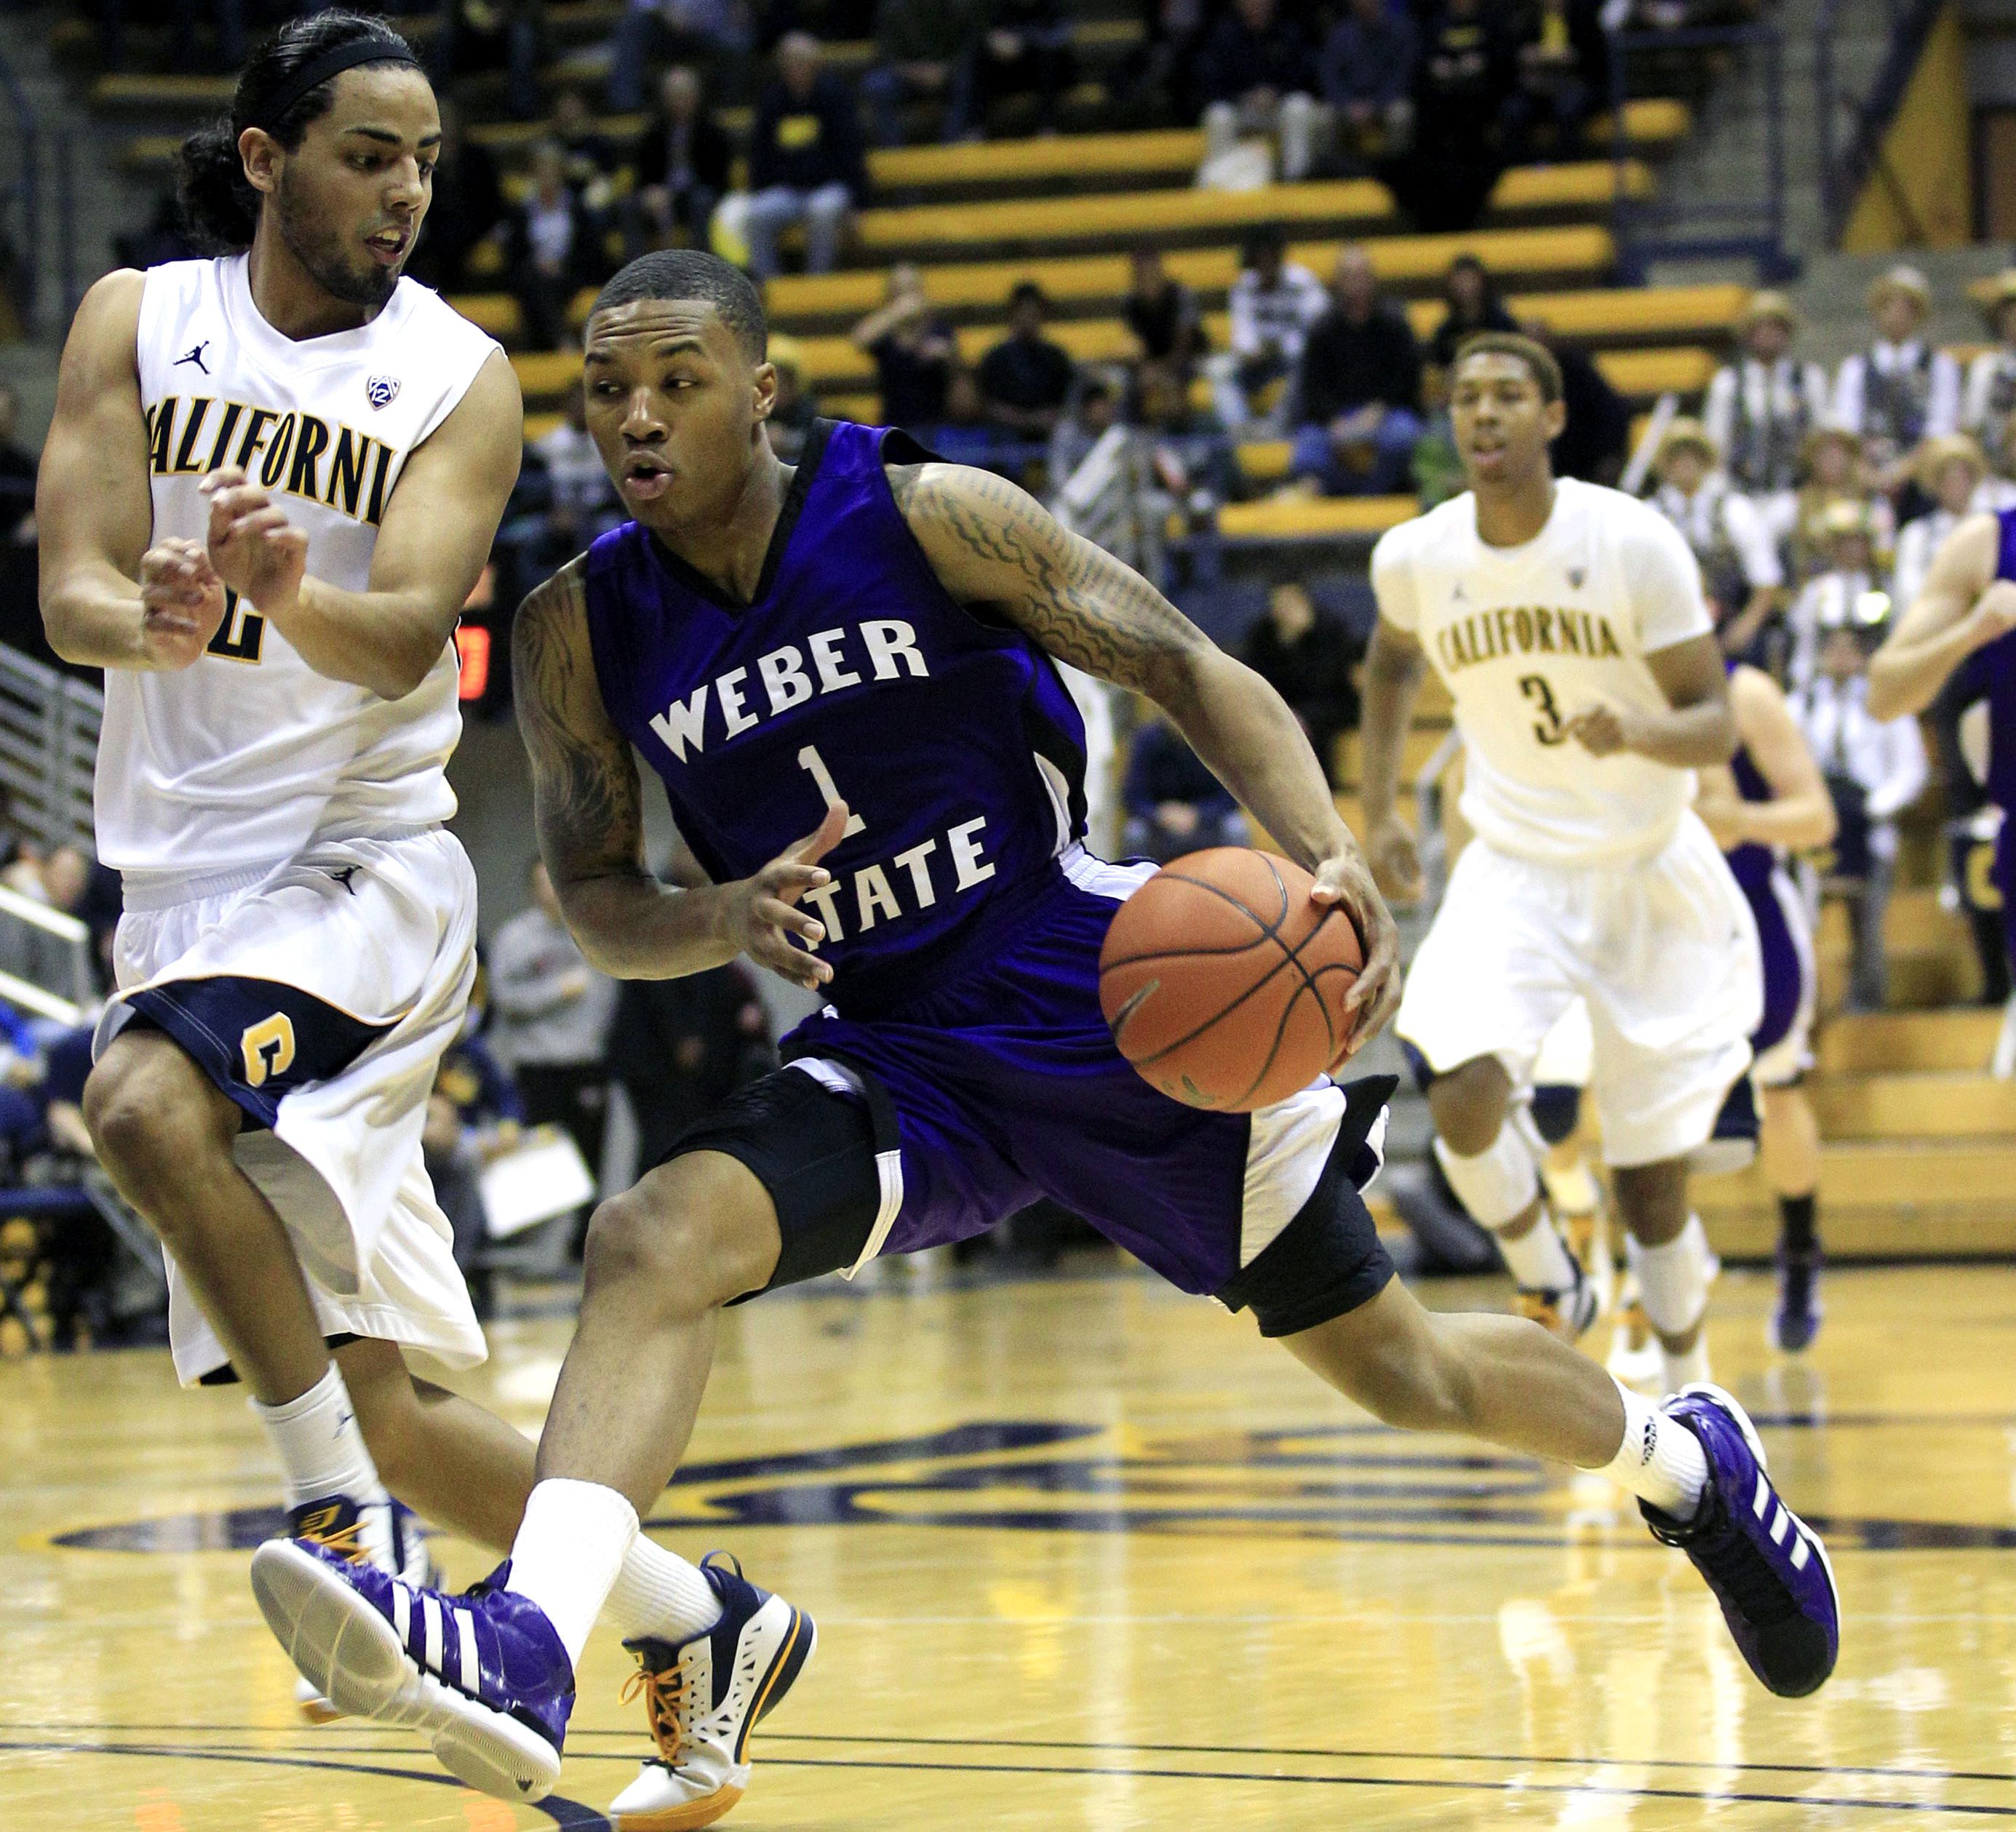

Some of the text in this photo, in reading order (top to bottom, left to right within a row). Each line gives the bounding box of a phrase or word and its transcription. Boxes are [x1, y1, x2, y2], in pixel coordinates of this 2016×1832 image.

[371, 388, 389, 403] 12
[146, 395, 397, 528] ALIFORNI
[1437, 606, 1622, 673] CALIFORNIA
[648, 619, 930, 764] WEBER
[1518, 674, 1566, 746] 3
[797, 744, 866, 839] 1
[793, 816, 996, 952] TATE
[241, 1011, 295, 1088] C
